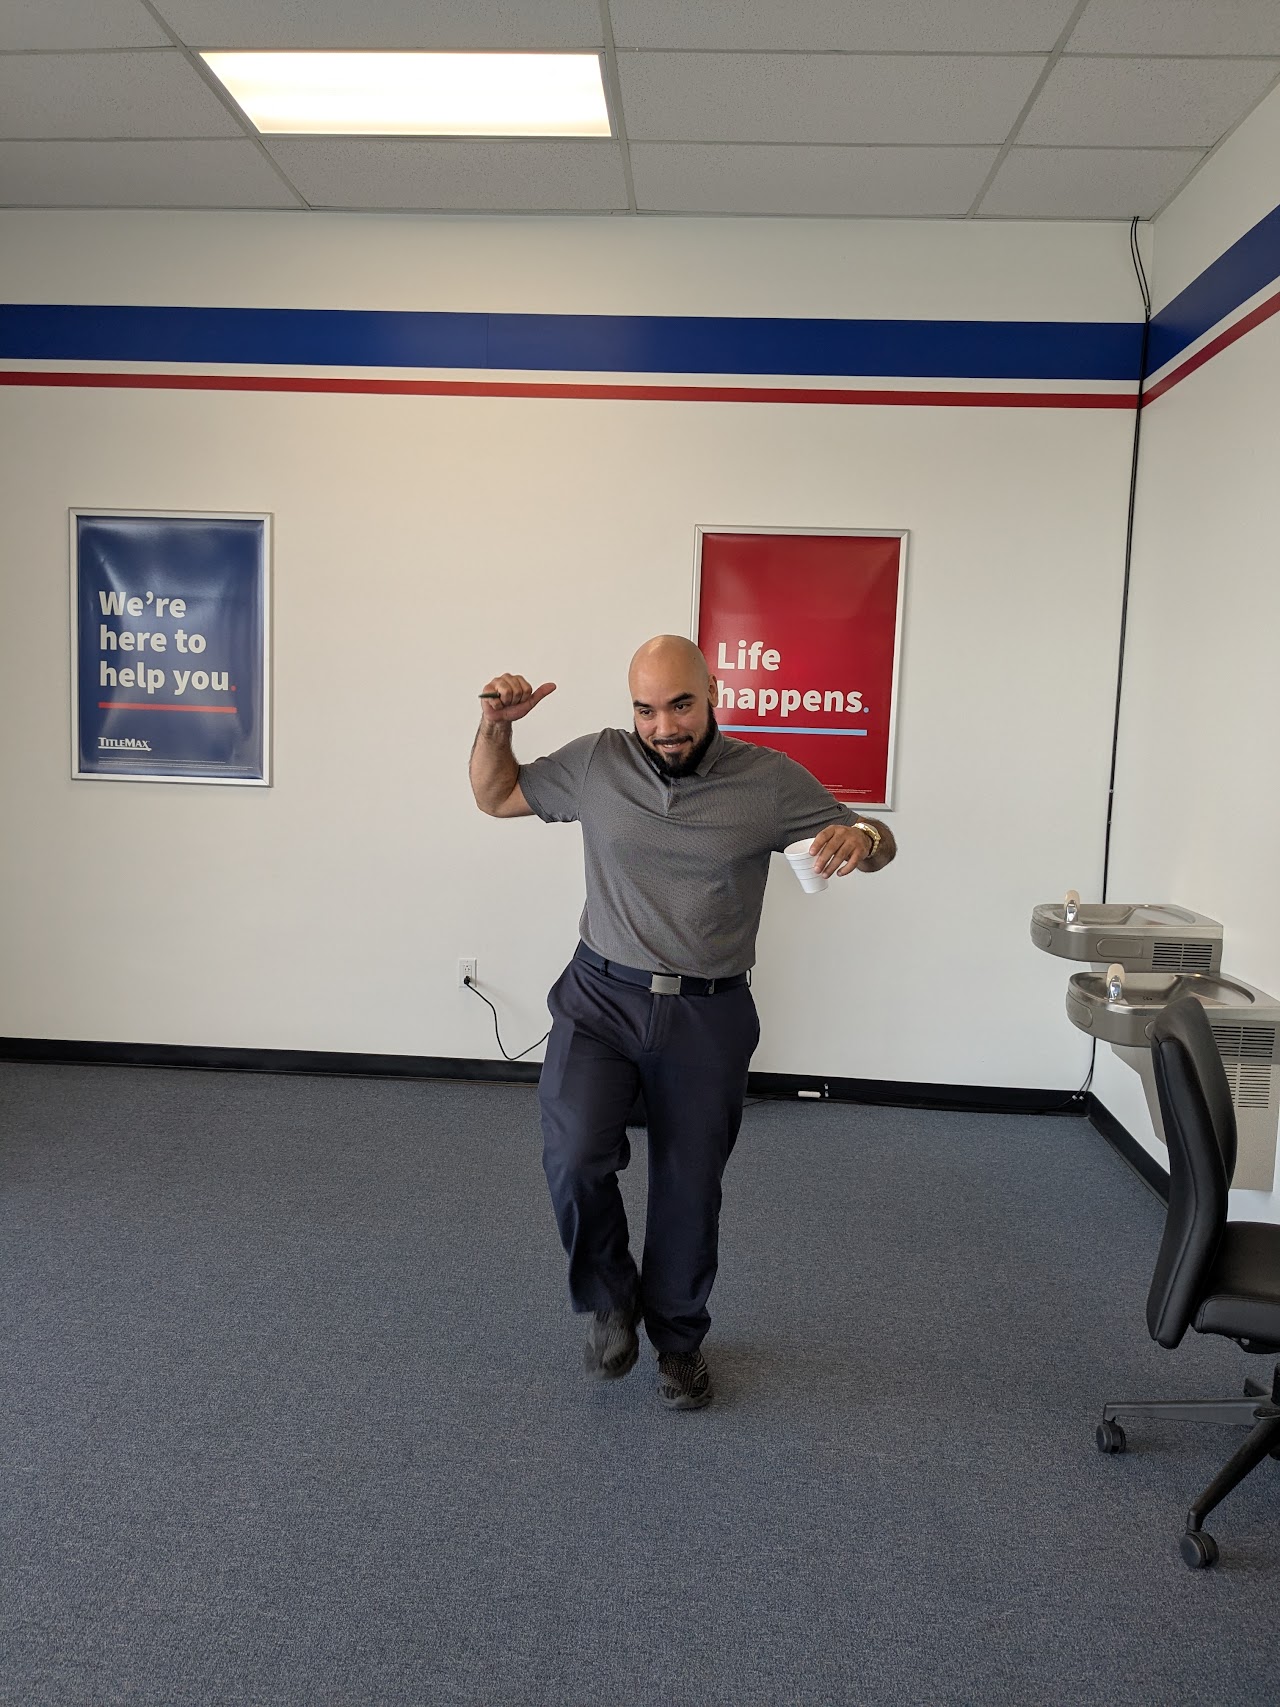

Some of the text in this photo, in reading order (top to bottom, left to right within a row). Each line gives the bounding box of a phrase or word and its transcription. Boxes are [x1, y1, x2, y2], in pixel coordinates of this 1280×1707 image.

[99, 591, 186, 618] We’re
[100, 624, 207, 654] here to
[717, 640, 781, 671] Life
[100, 661, 236, 695] help you.
[717, 680, 869, 717] happens.
